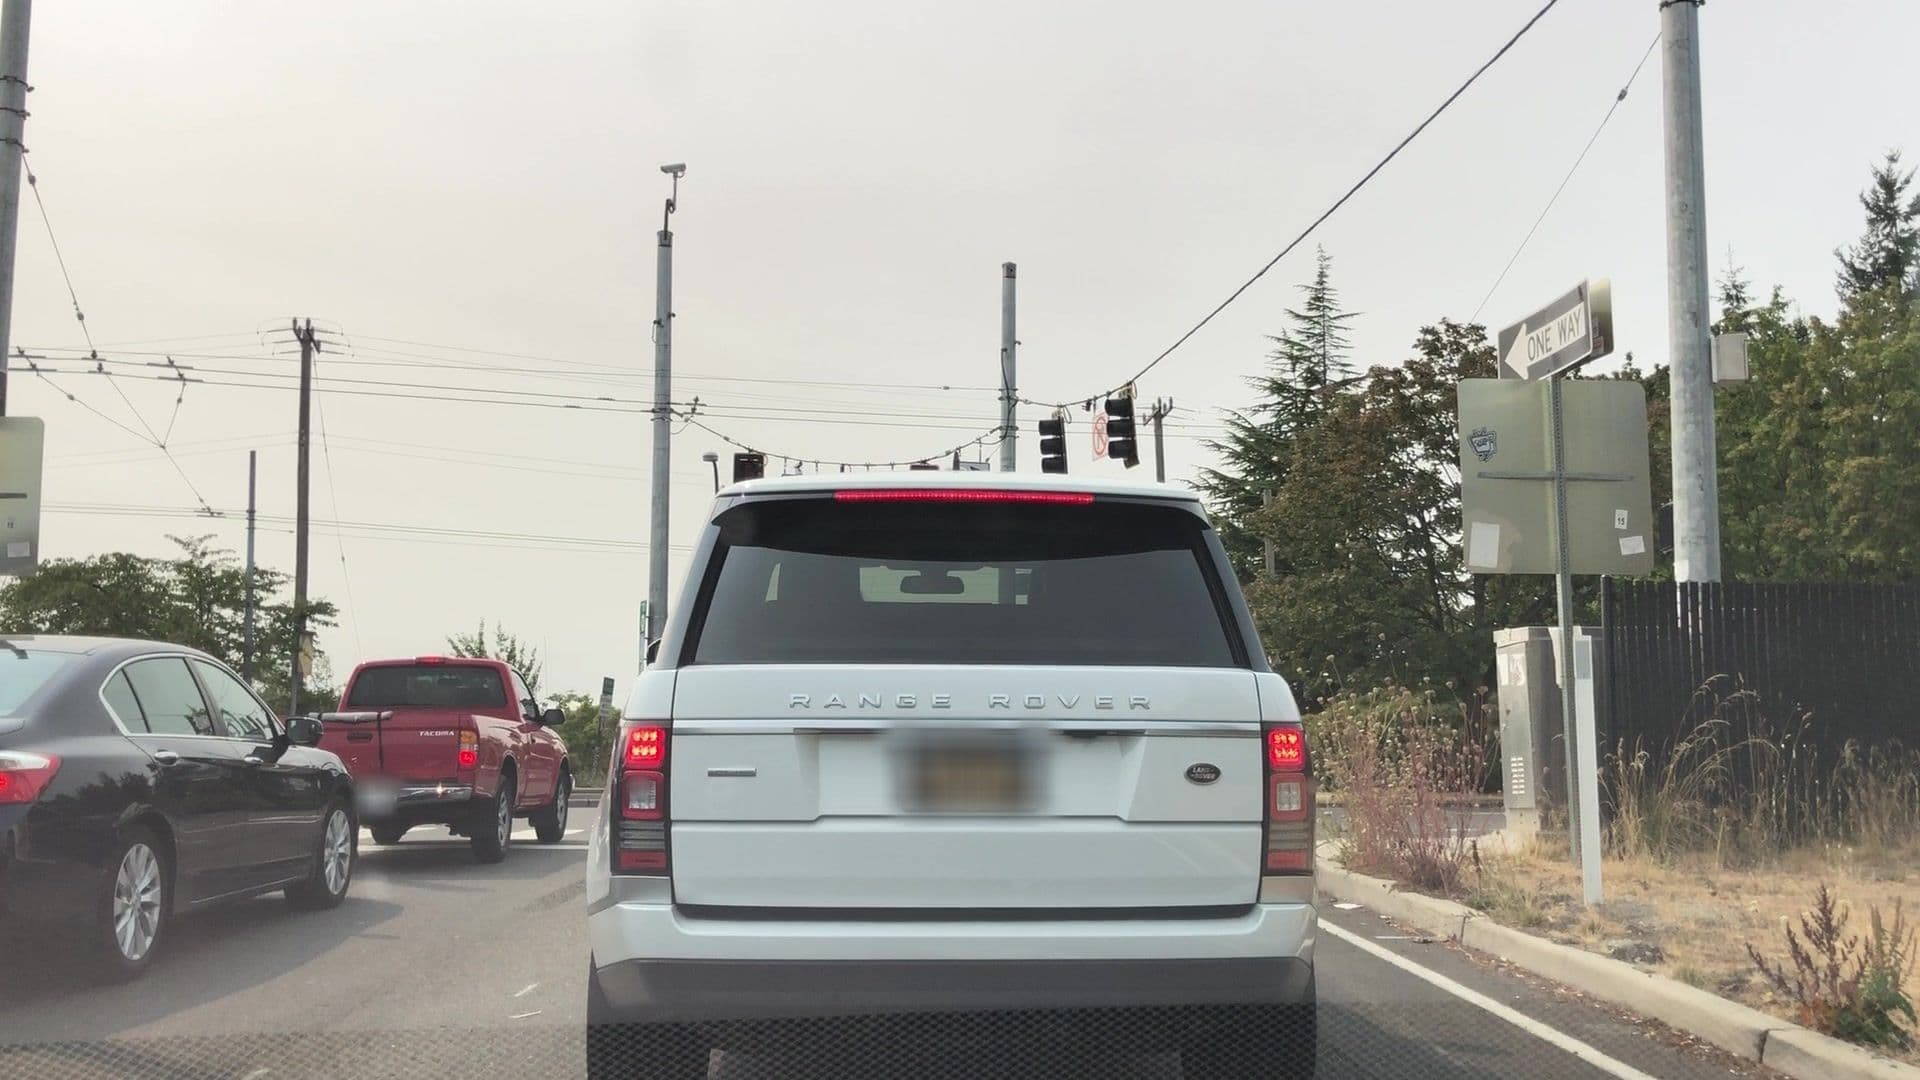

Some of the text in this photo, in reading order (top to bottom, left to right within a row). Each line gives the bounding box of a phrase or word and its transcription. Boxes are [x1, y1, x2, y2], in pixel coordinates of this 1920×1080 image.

[1527, 327, 1552, 361] ONE
[1557, 307, 1582, 345] WAY
[789, 693, 1151, 710] RANGE ROVER
